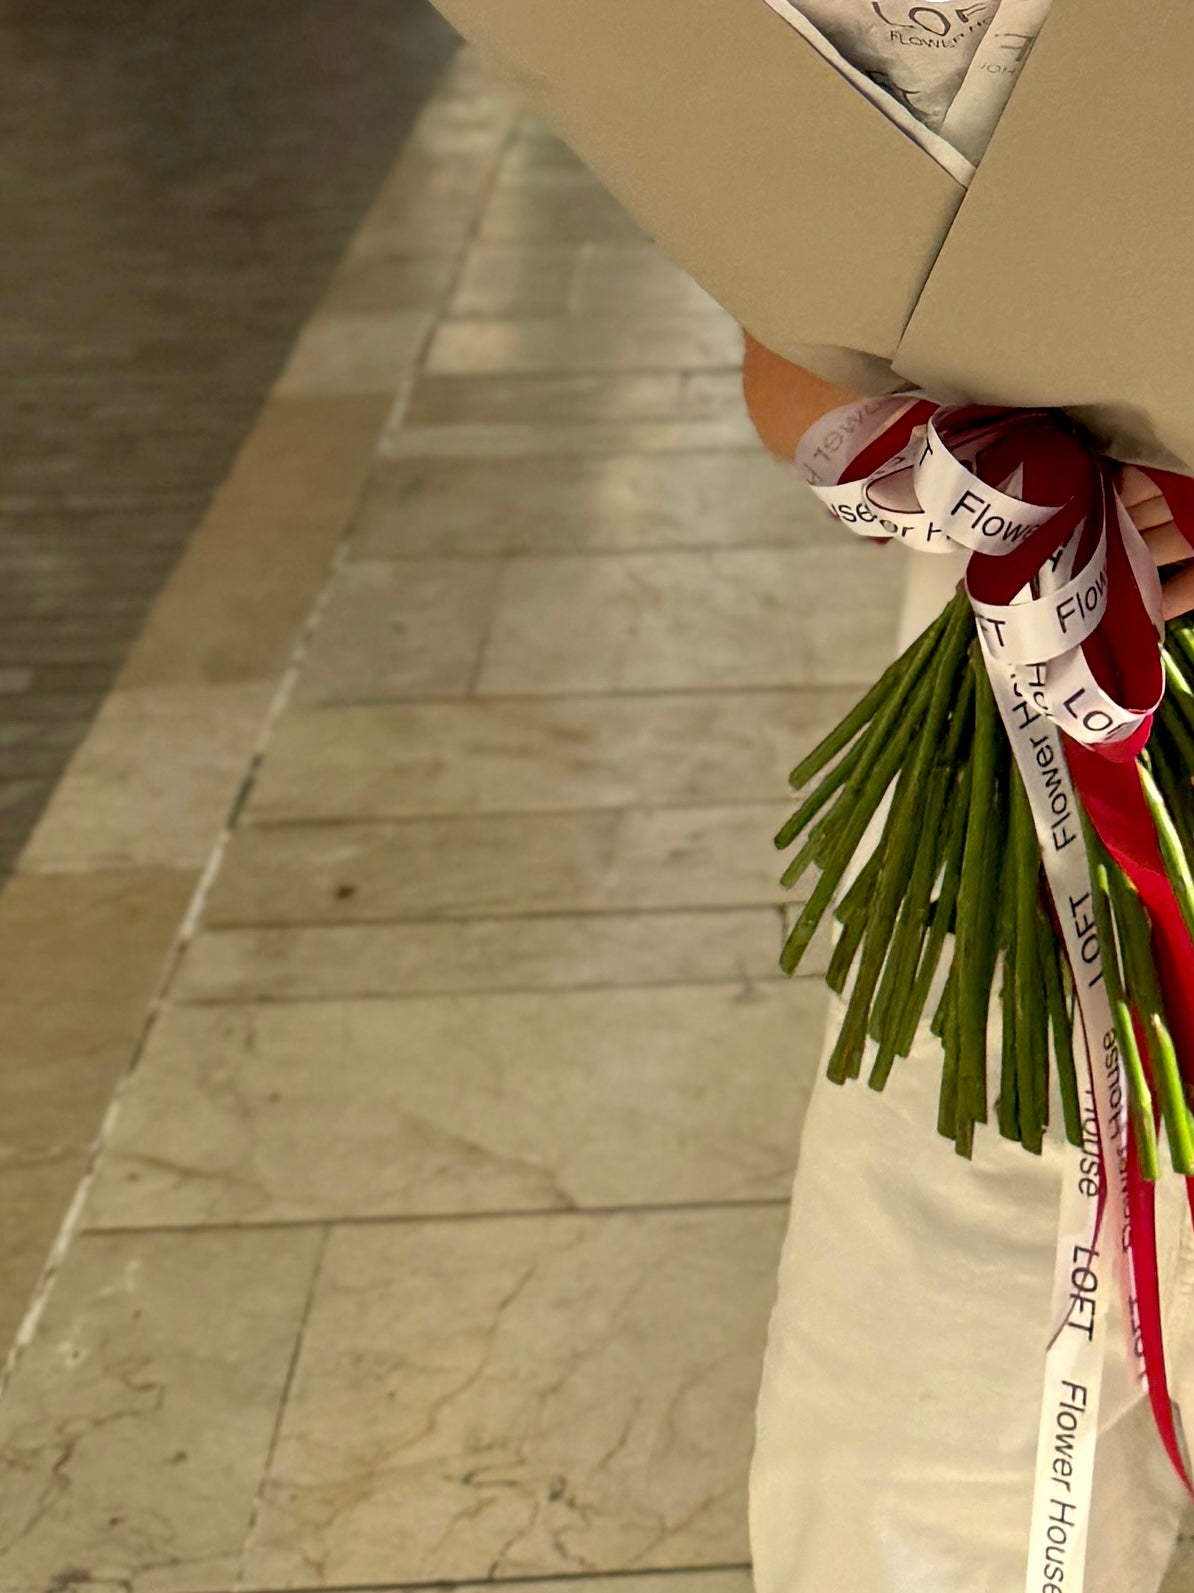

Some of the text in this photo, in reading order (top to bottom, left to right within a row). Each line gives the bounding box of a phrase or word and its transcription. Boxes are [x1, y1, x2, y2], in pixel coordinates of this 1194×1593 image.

[950, 489, 1041, 544] Flow
[1056, 570, 1108, 634] Flow
[1063, 687, 1124, 734] LO
[1030, 735, 1077, 852] Flower
[1067, 1244, 1100, 1342] LOFT
[1042, 1379, 1088, 1593] Flower House
